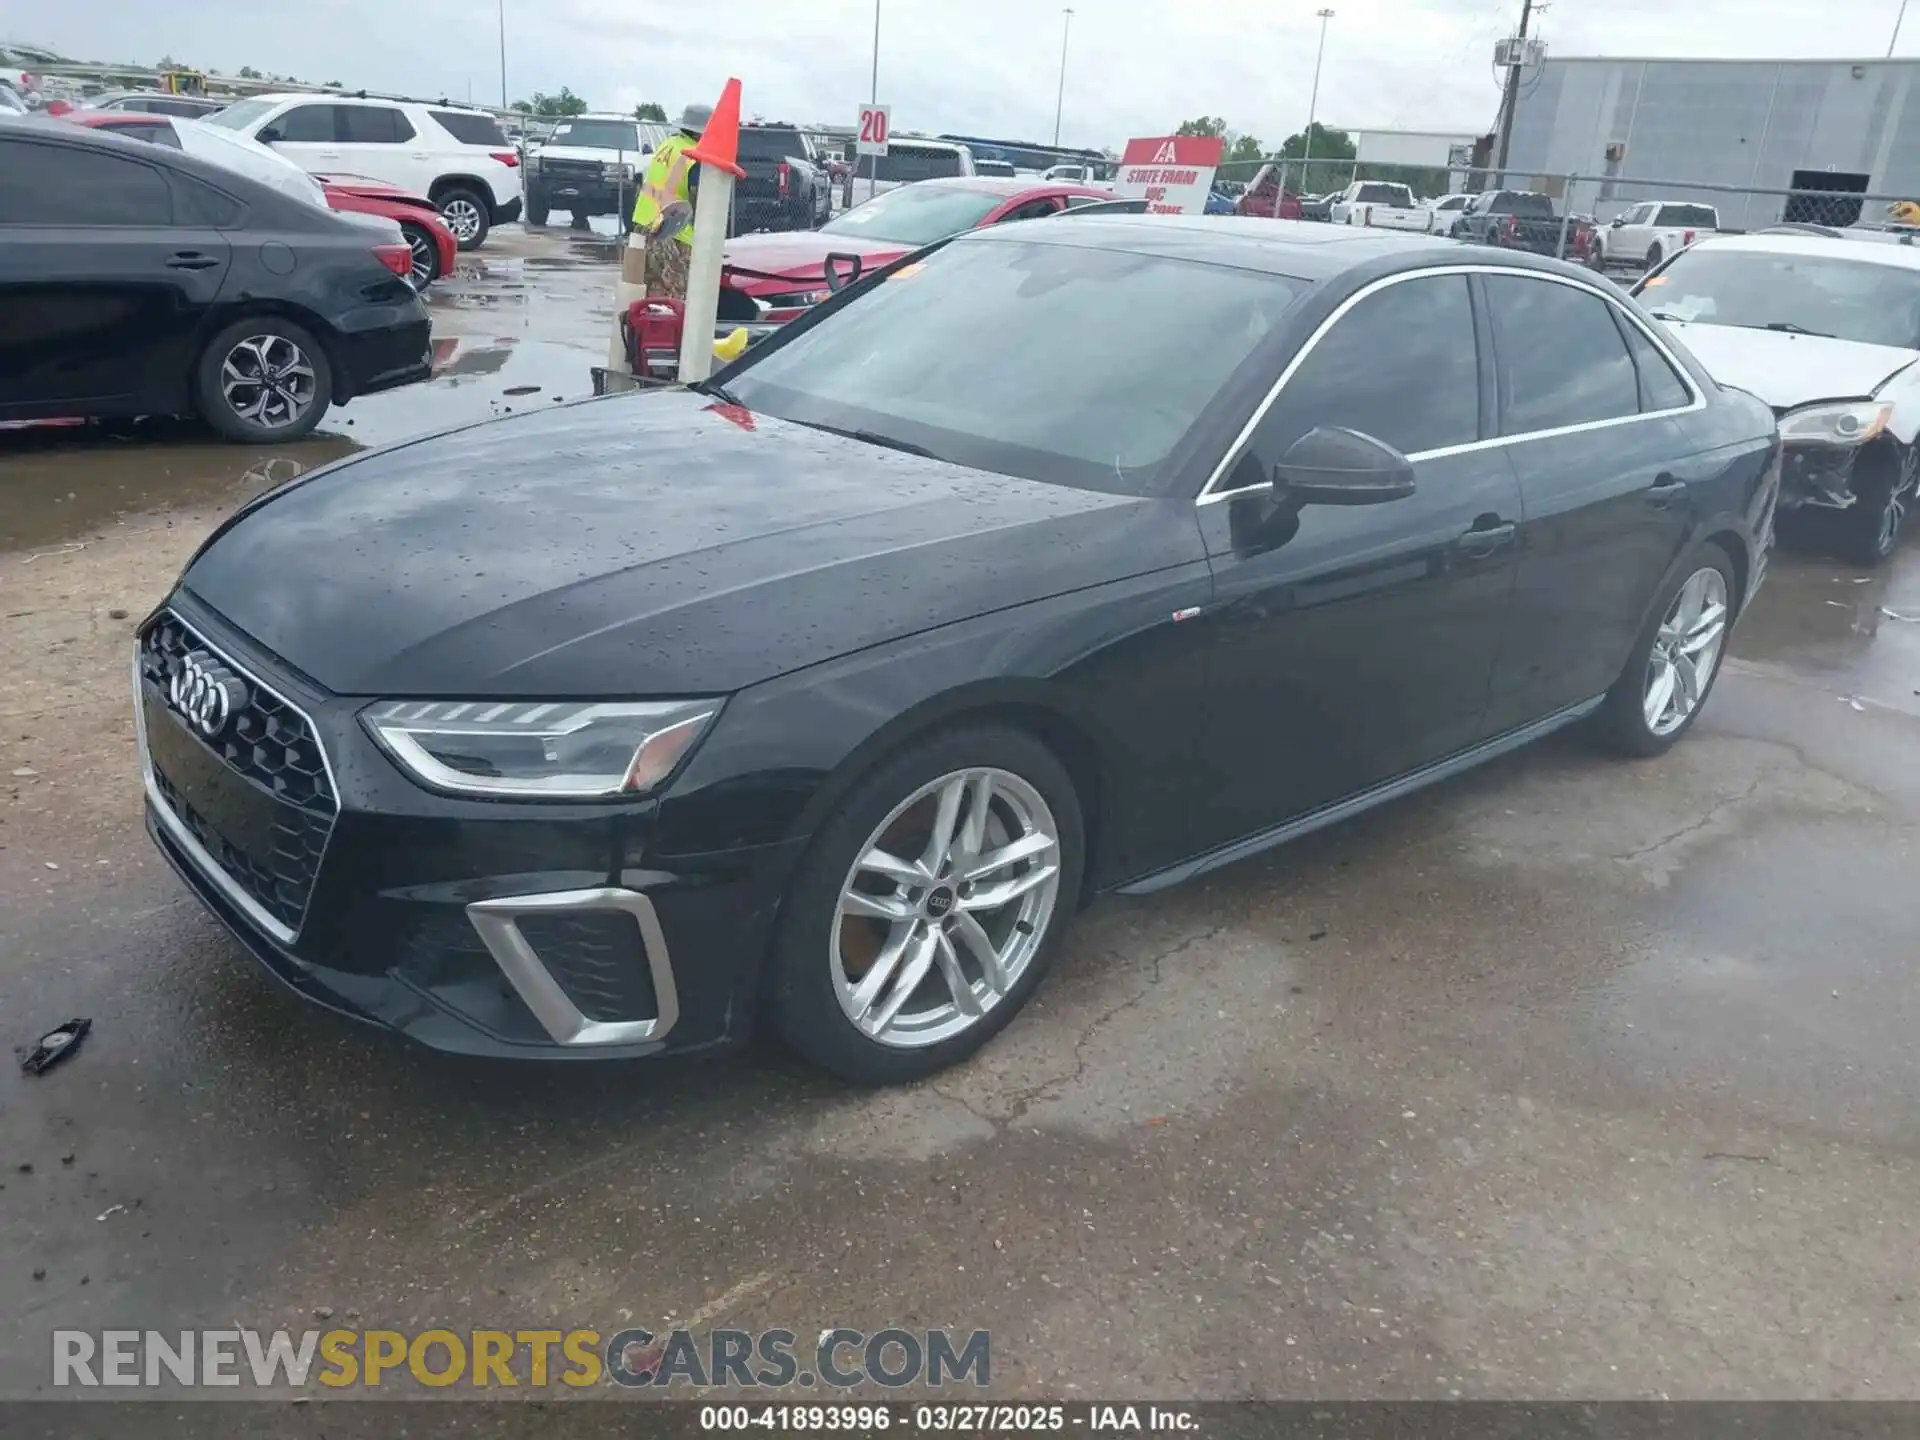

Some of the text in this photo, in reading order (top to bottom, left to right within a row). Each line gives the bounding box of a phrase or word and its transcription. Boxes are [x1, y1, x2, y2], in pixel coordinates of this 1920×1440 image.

[860, 110, 886, 143] 20
[1126, 169, 1198, 185] STATE FARM
